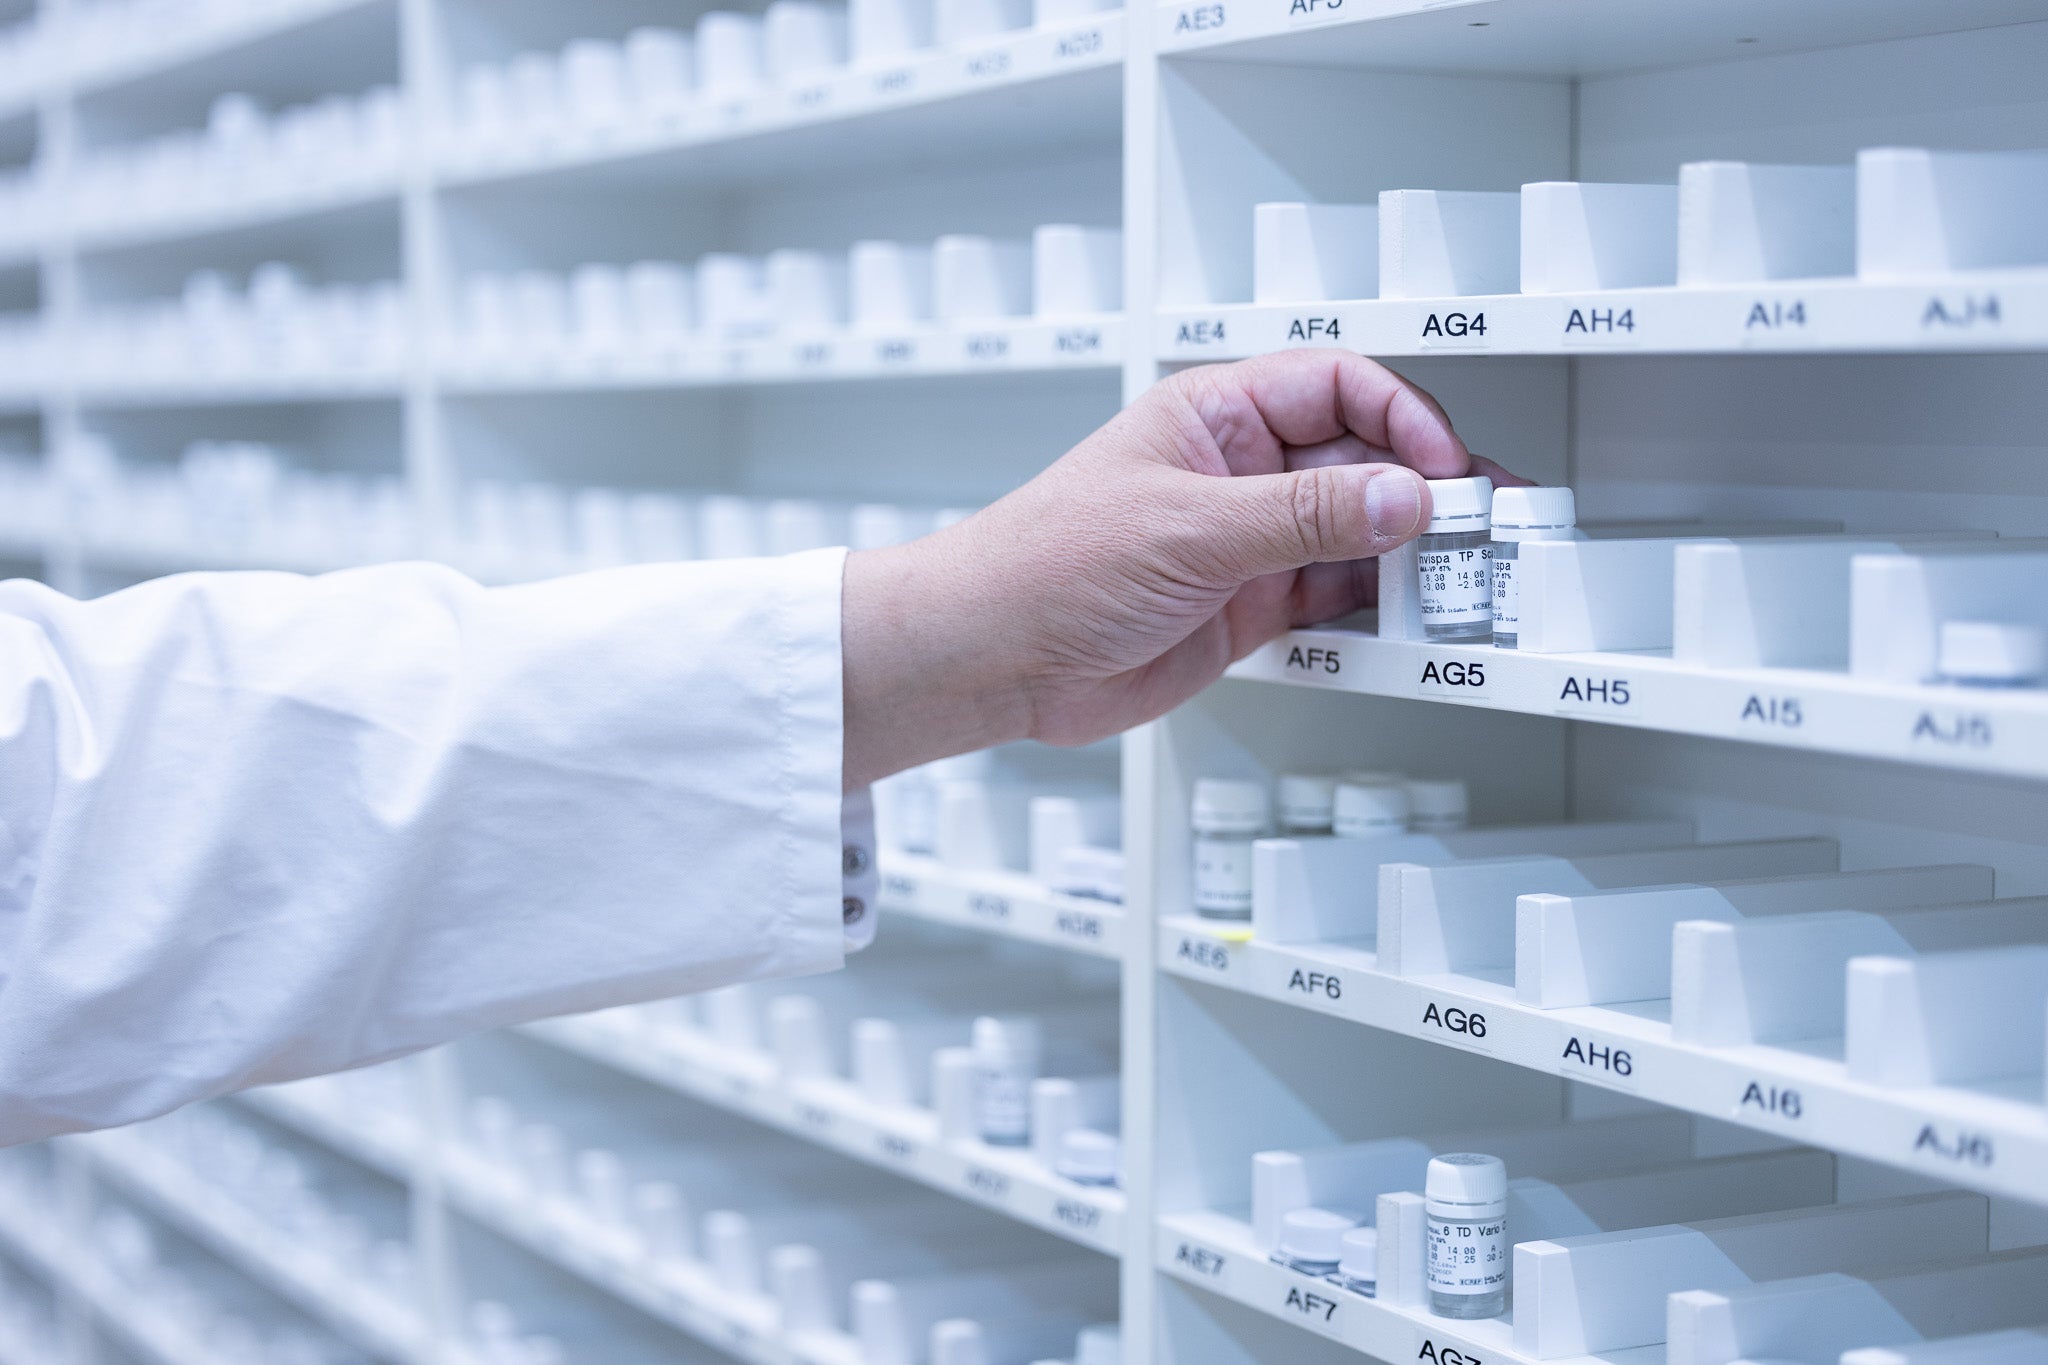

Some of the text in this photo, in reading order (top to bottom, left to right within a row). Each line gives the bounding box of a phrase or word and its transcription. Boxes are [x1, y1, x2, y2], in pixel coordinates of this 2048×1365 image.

[1175, 6, 1225, 33] AE3
[1422, 312, 1487, 337] AG4
[1565, 308, 1635, 334] AH4
[1746, 301, 1807, 328] AI4
[1922, 294, 2002, 327] AJ4
[1176, 320, 1225, 344] AE4
[1288, 318, 1341, 340] AF4
[1459, 551, 1474, 562] TP
[1424, 579, 1485, 592] -3.00 -2.00
[1426, 573, 1445, 582] 8.30
[1458, 570, 1484, 580] 14.00
[1287, 645, 1341, 674] AF5
[1421, 661, 1485, 687] AG5
[1560, 676, 1630, 705] AH5
[1741, 693, 1802, 727] AI5
[1911, 709, 1993, 747] AJ5
[1177, 936, 1228, 970] AE6
[1289, 969, 1341, 1000] AF6
[1422, 1002, 1487, 1038] AG6
[1562, 1037, 1632, 1076] AH6
[1741, 1081, 1802, 1120] AI6
[1913, 1123, 1994, 1168] AJ6
[1443, 1226, 1450, 1236] 6
[1456, 1227, 1471, 1237] TD
[1478, 1224, 1500, 1237] Vario
[1176, 1242, 1224, 1275] AE7
[1448, 1246, 1476, 1255] 14.00
[1448, 1255, 1476, 1264] -1.25
[1286, 1287, 1338, 1321] AF7
